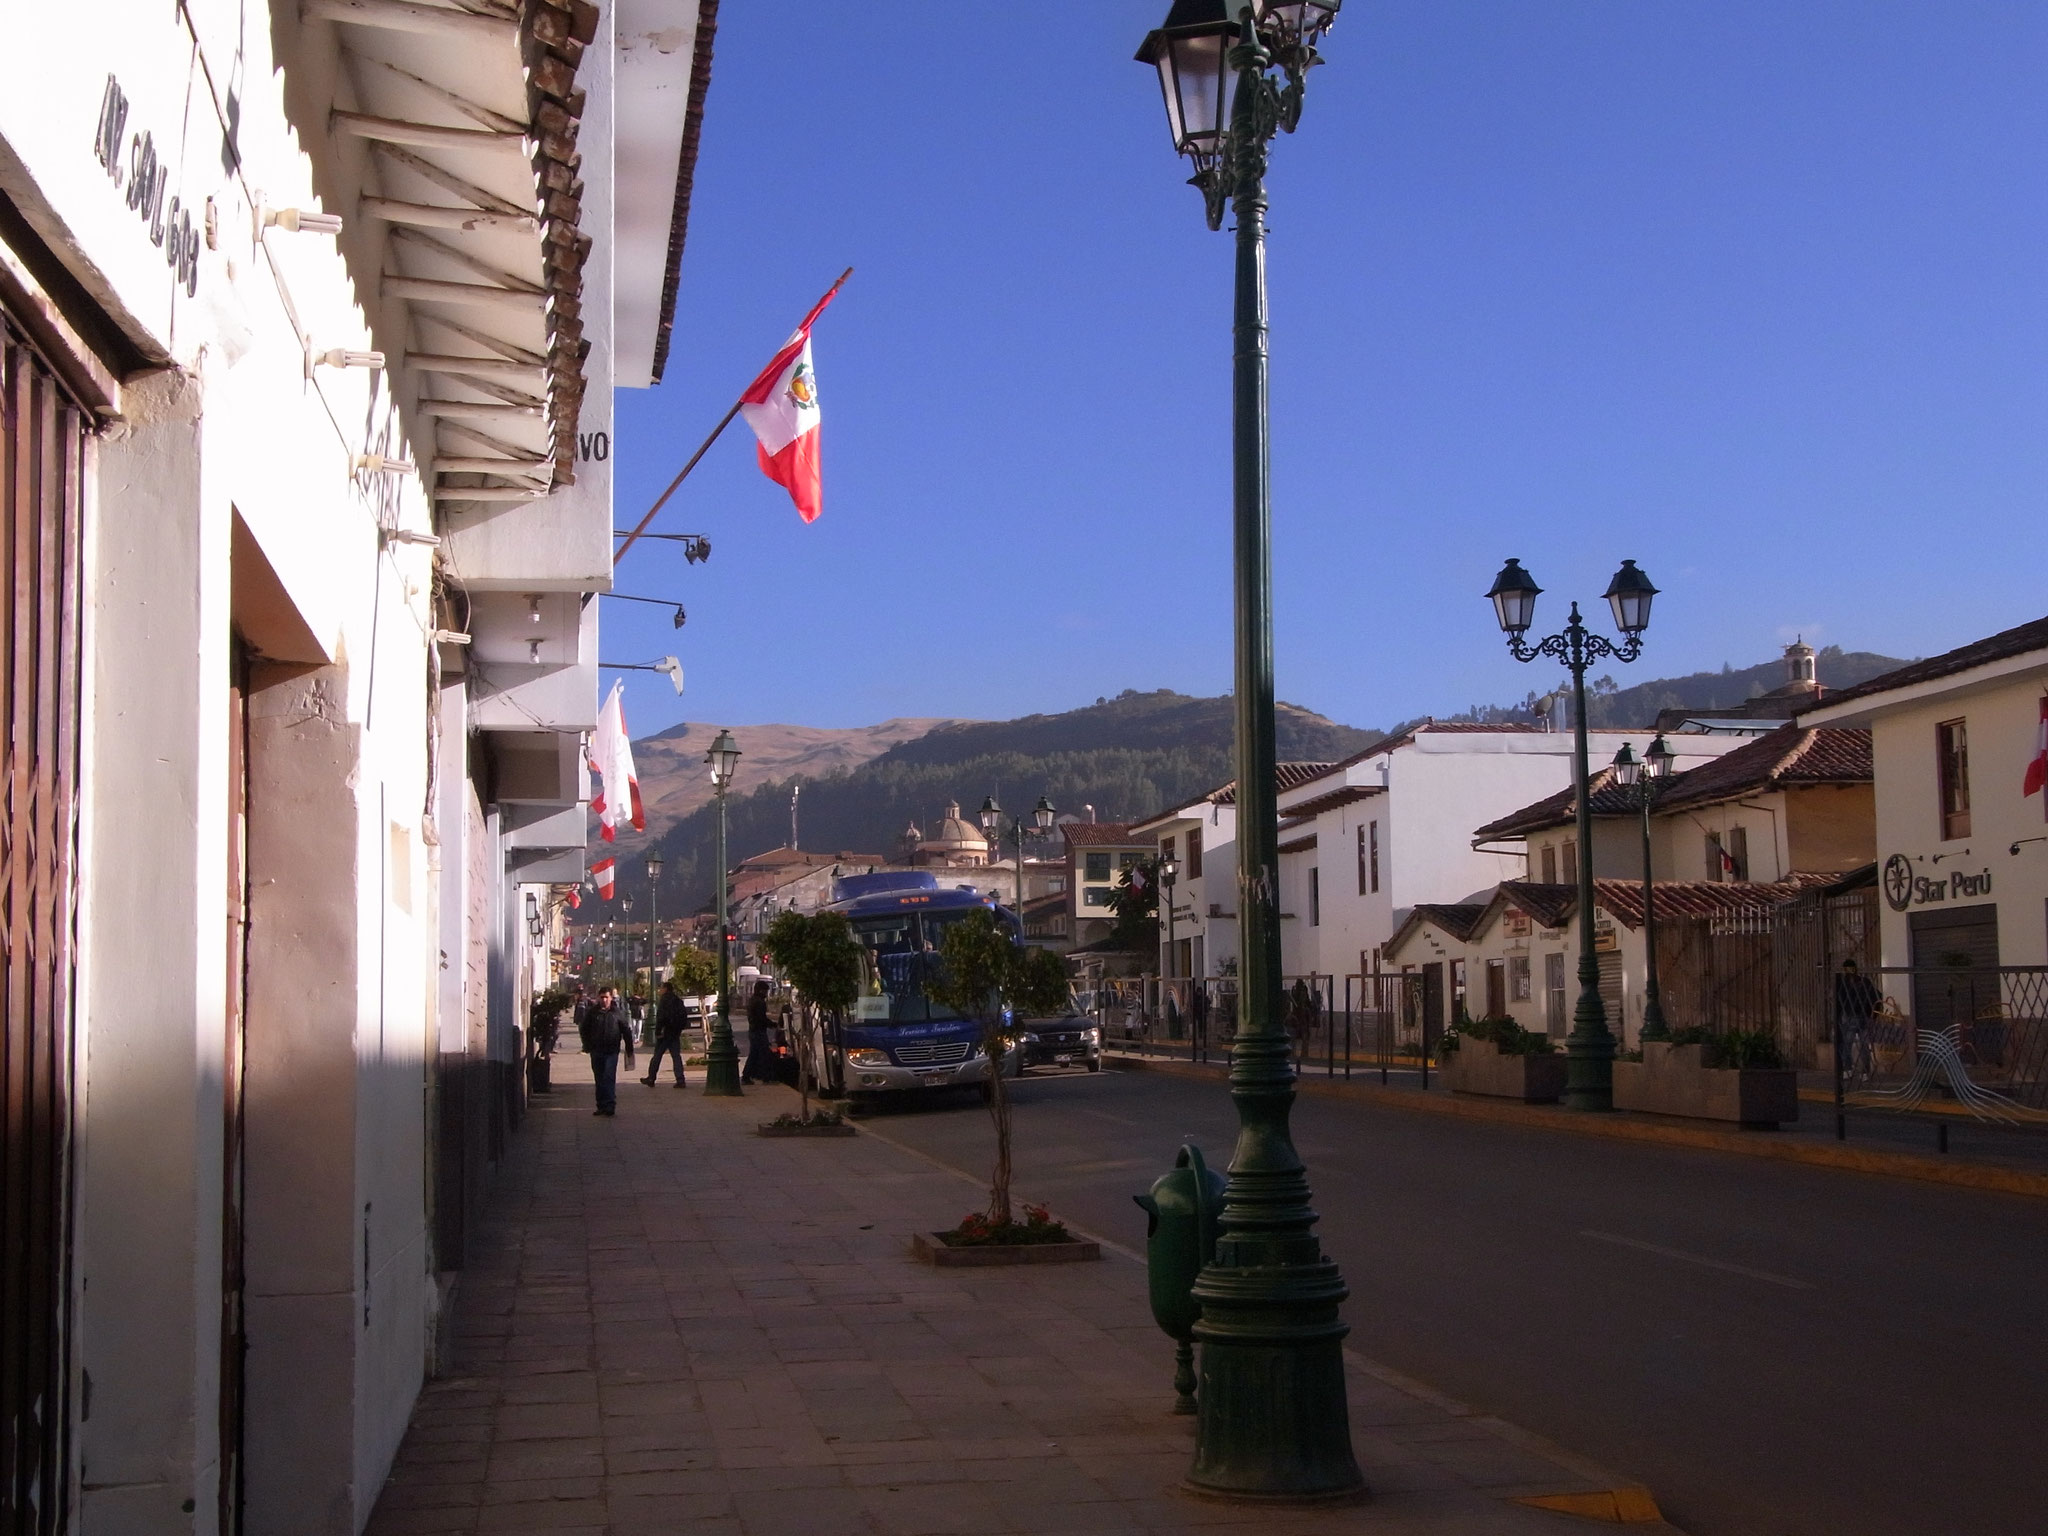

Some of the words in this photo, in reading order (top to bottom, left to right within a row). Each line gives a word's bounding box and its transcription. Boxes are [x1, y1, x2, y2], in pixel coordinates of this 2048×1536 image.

[126, 129, 168, 248] SOL
[1914, 876, 1947, 904] Star
[1951, 867, 1991, 899] Perú
[898, 1027, 928, 1037] Servicio
